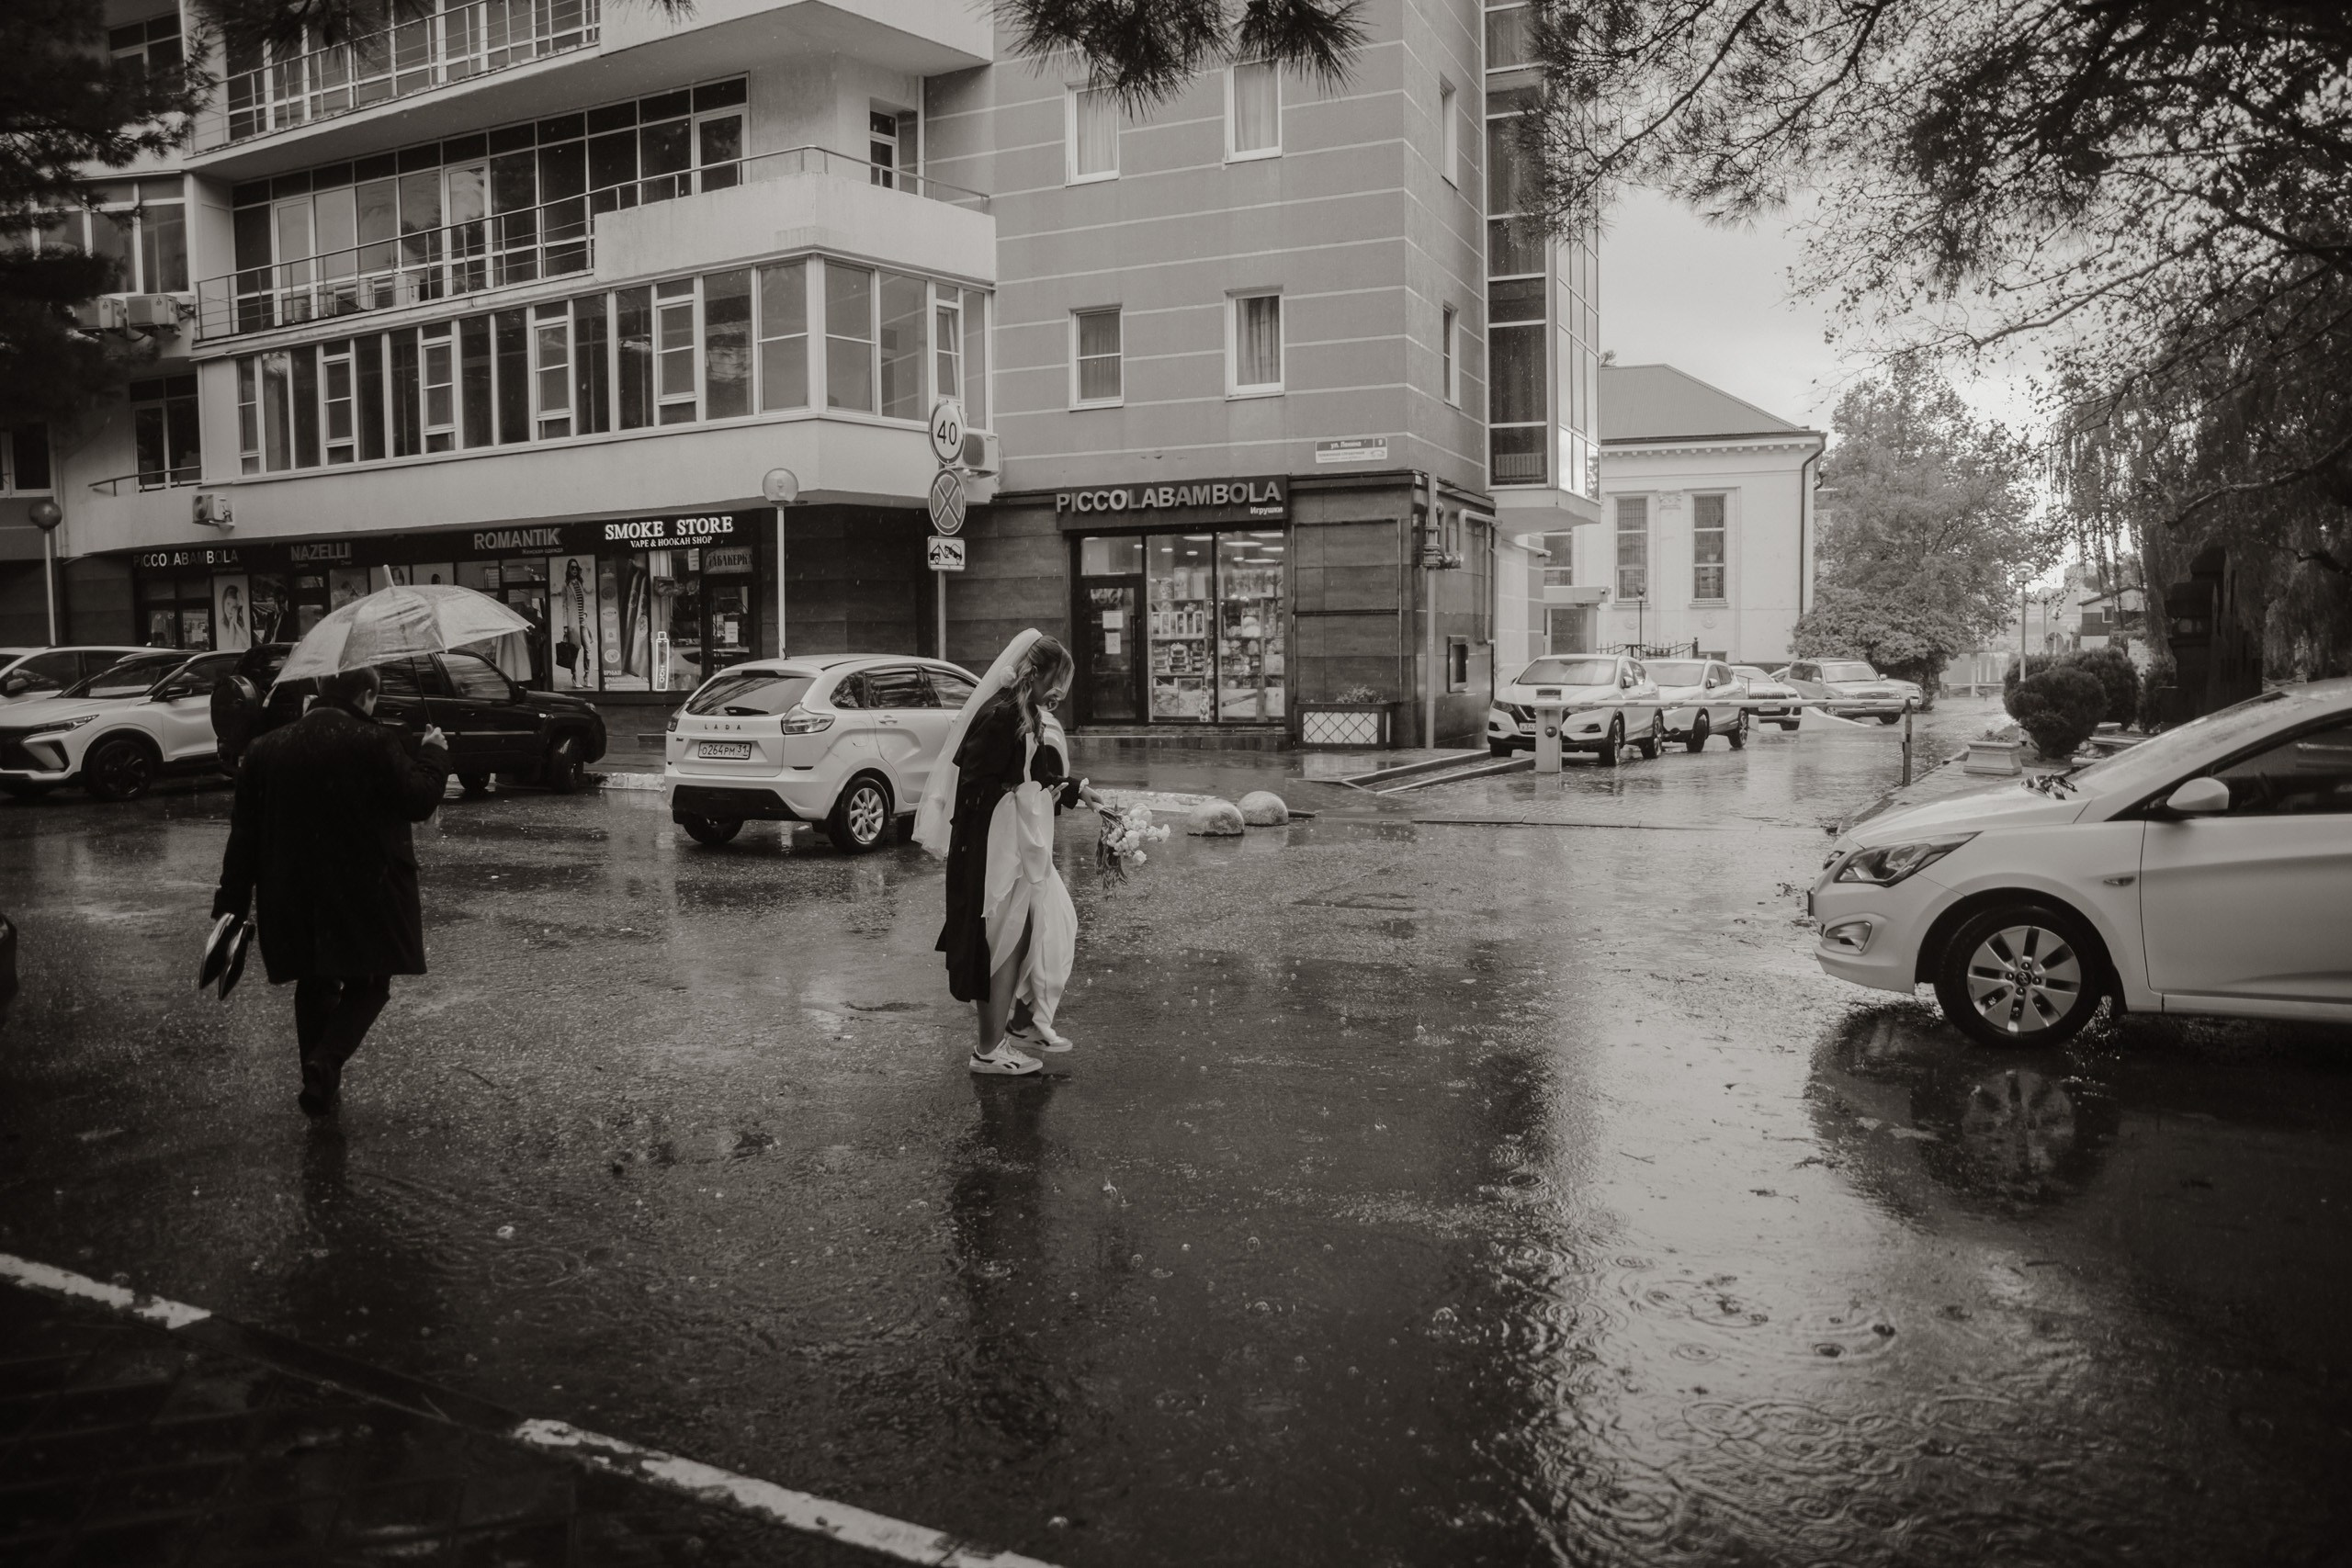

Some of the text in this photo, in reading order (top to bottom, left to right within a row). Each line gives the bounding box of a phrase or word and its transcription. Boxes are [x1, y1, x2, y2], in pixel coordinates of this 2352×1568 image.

[936, 420, 957, 446] 40
[1056, 481, 1283, 513] PICCOLABAMBOLA
[1250, 506, 1283, 515] Игрушки
[474, 527, 561, 550] ROMANTIK
[605, 516, 734, 540] SMOKE STORE
[290, 542, 351, 561] NAZELLI
[630, 536, 713, 548] VAPE & HOOKAH SHOP
